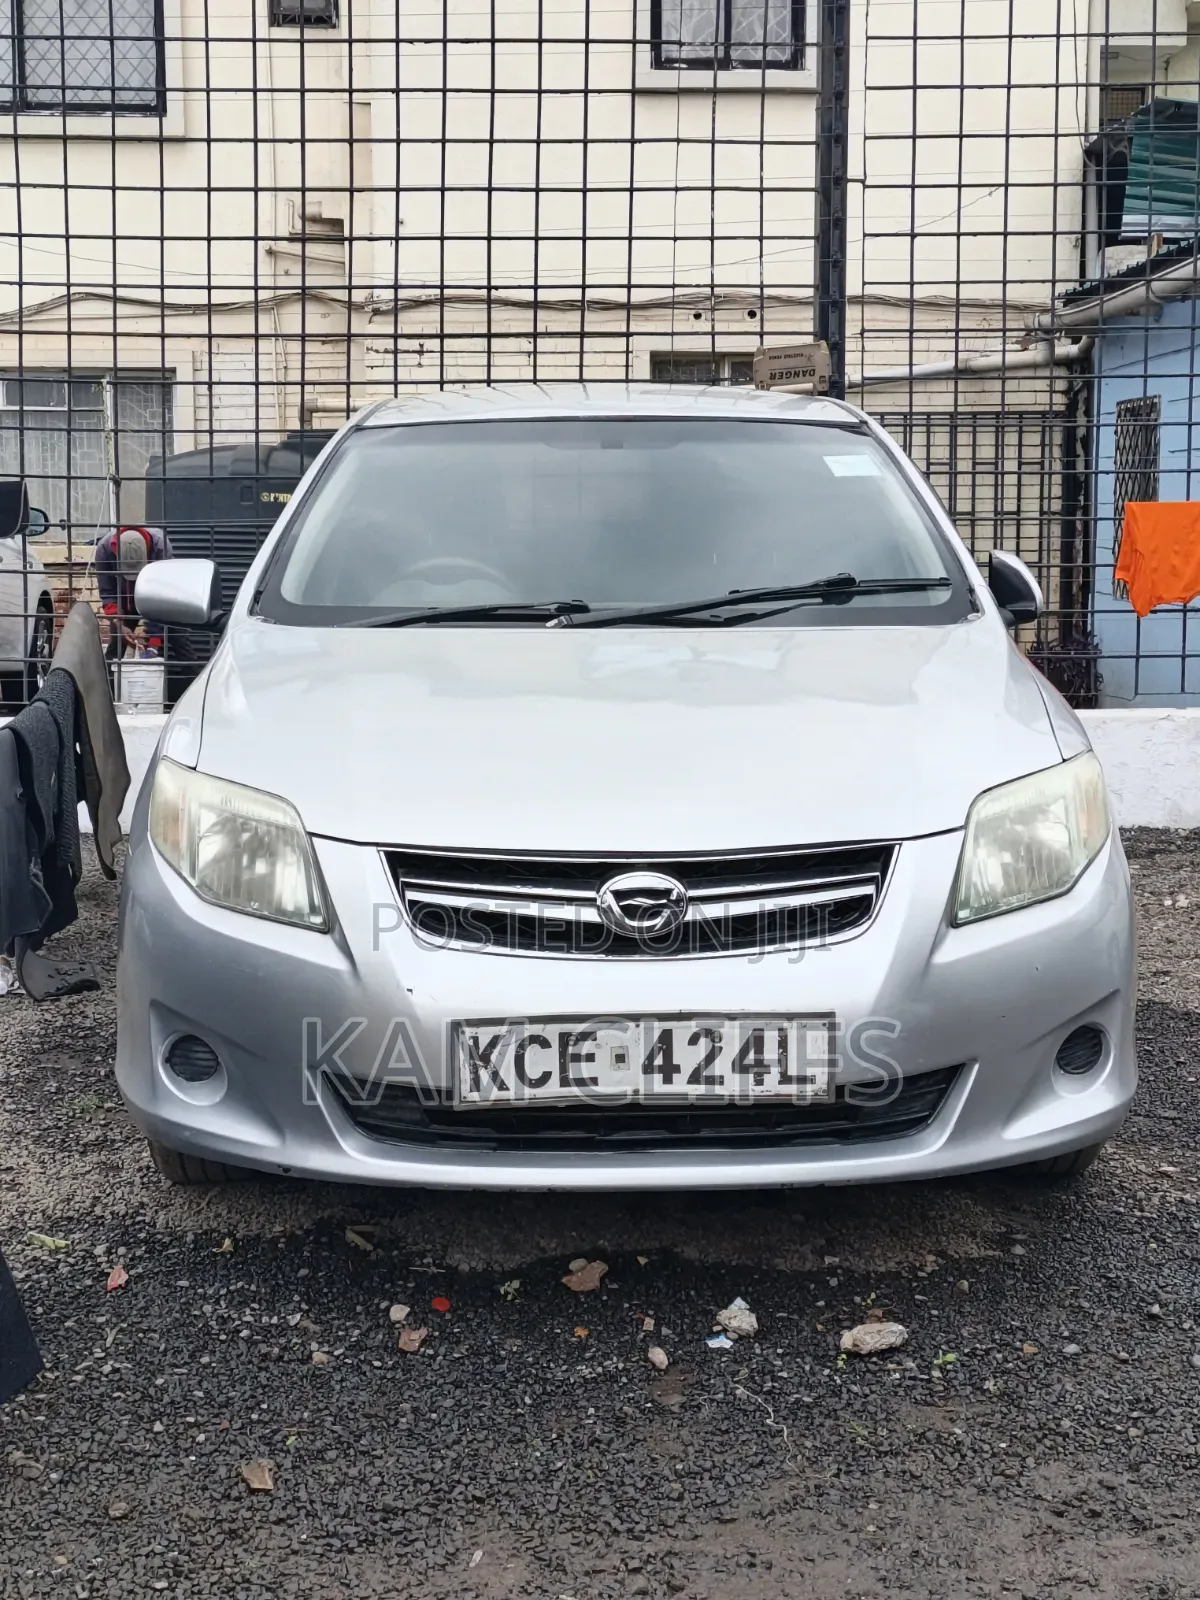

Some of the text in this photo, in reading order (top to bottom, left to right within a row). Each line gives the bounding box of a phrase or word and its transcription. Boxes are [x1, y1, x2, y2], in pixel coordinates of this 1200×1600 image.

[769, 368, 816, 380] DANGER
[469, 1028, 817, 1093] KCE 424L
